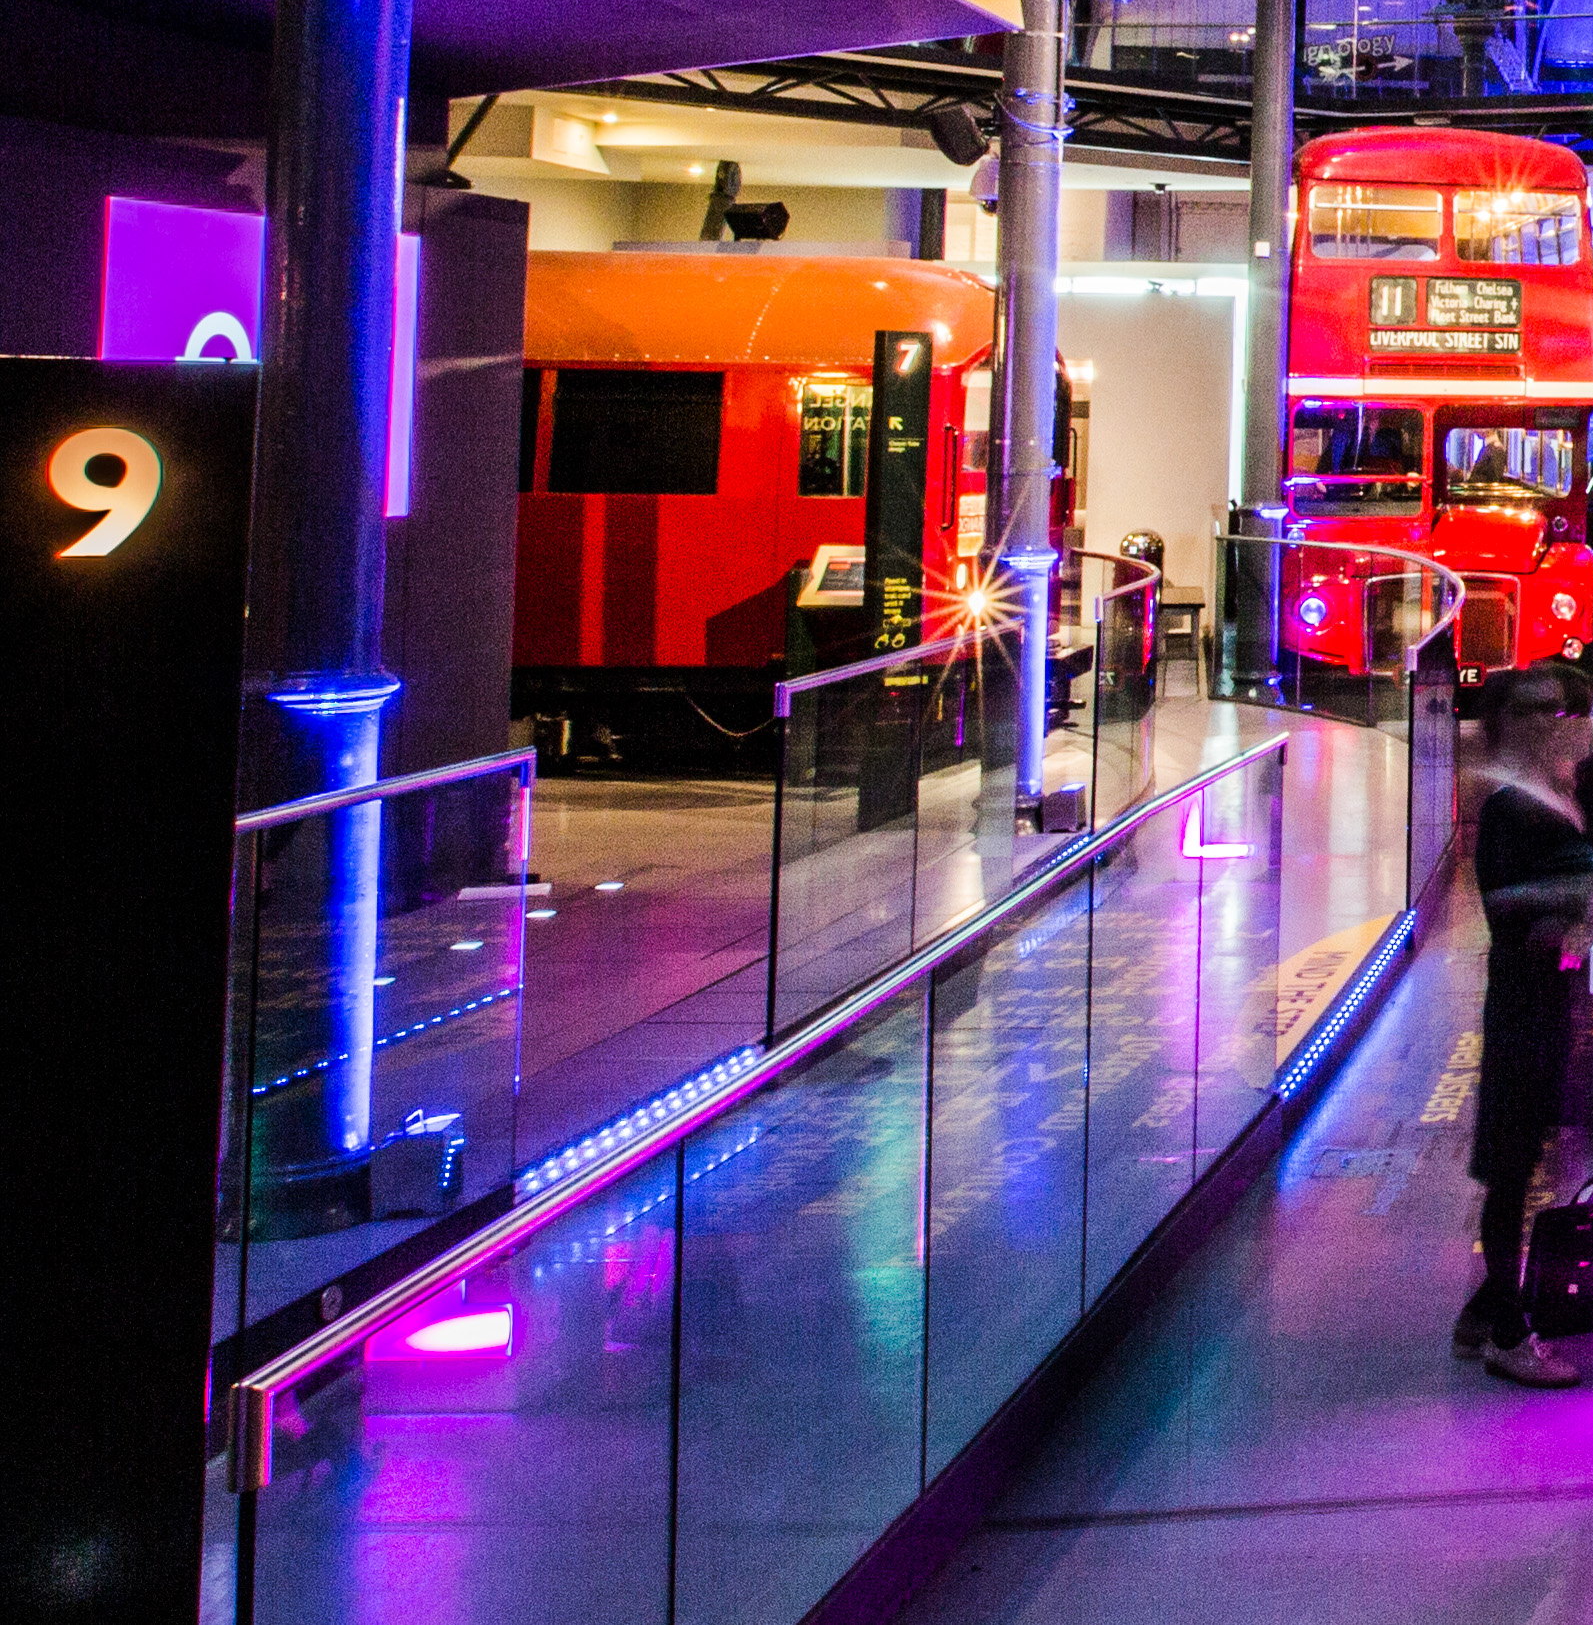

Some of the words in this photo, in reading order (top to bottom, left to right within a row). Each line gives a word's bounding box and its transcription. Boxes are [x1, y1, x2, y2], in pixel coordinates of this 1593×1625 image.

[1381, 285, 1403, 317] 11
[1434, 281, 1469, 294] Fulham
[1476, 281, 1514, 296] Chelsea
[1429, 295, 1468, 309] Victoria
[1473, 296, 1508, 312] Charing
[1459, 310, 1490, 324] Street
[1493, 311, 1517, 324] Bank
[1370, 331, 1441, 347] LIVERPOOL
[1445, 332, 1489, 349] STREET
[1494, 333, 1519, 350] STN
[899, 343, 921, 373] 7
[47, 426, 163, 559] 9
[1295, 950, 1353, 980] MIND
[1277, 981, 1328, 1005] THE
[1419, 1071, 1481, 1123] Sisters
